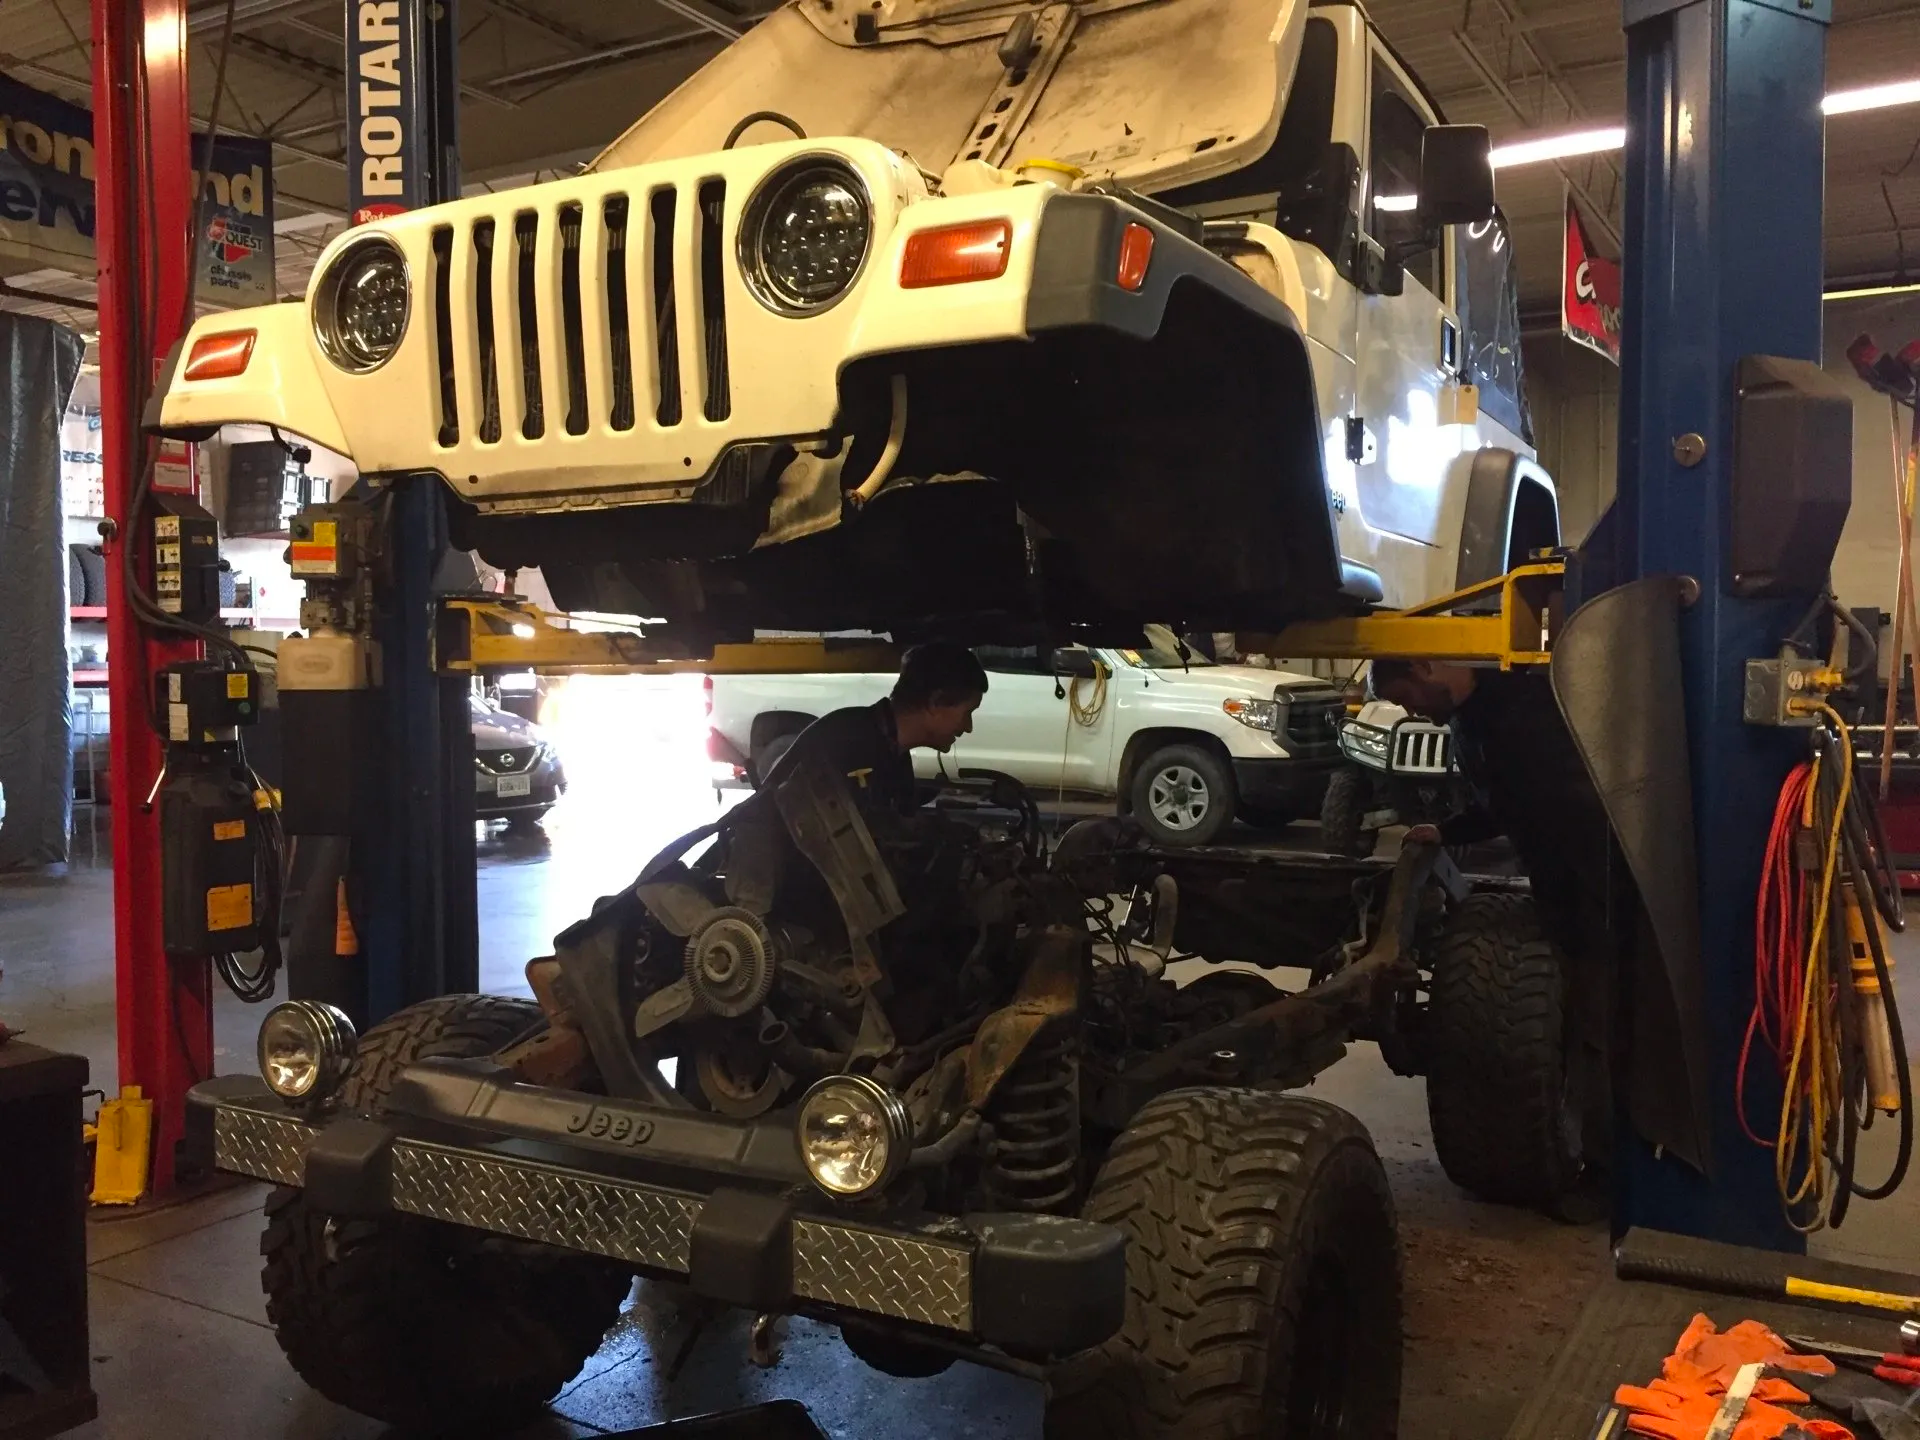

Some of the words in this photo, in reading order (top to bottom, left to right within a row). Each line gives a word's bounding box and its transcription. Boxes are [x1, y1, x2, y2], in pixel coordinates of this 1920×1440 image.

[359, 0, 403, 196] ROTAR
[226, 232, 263, 250] QUEST
[566, 1104, 655, 1148] Jeep
